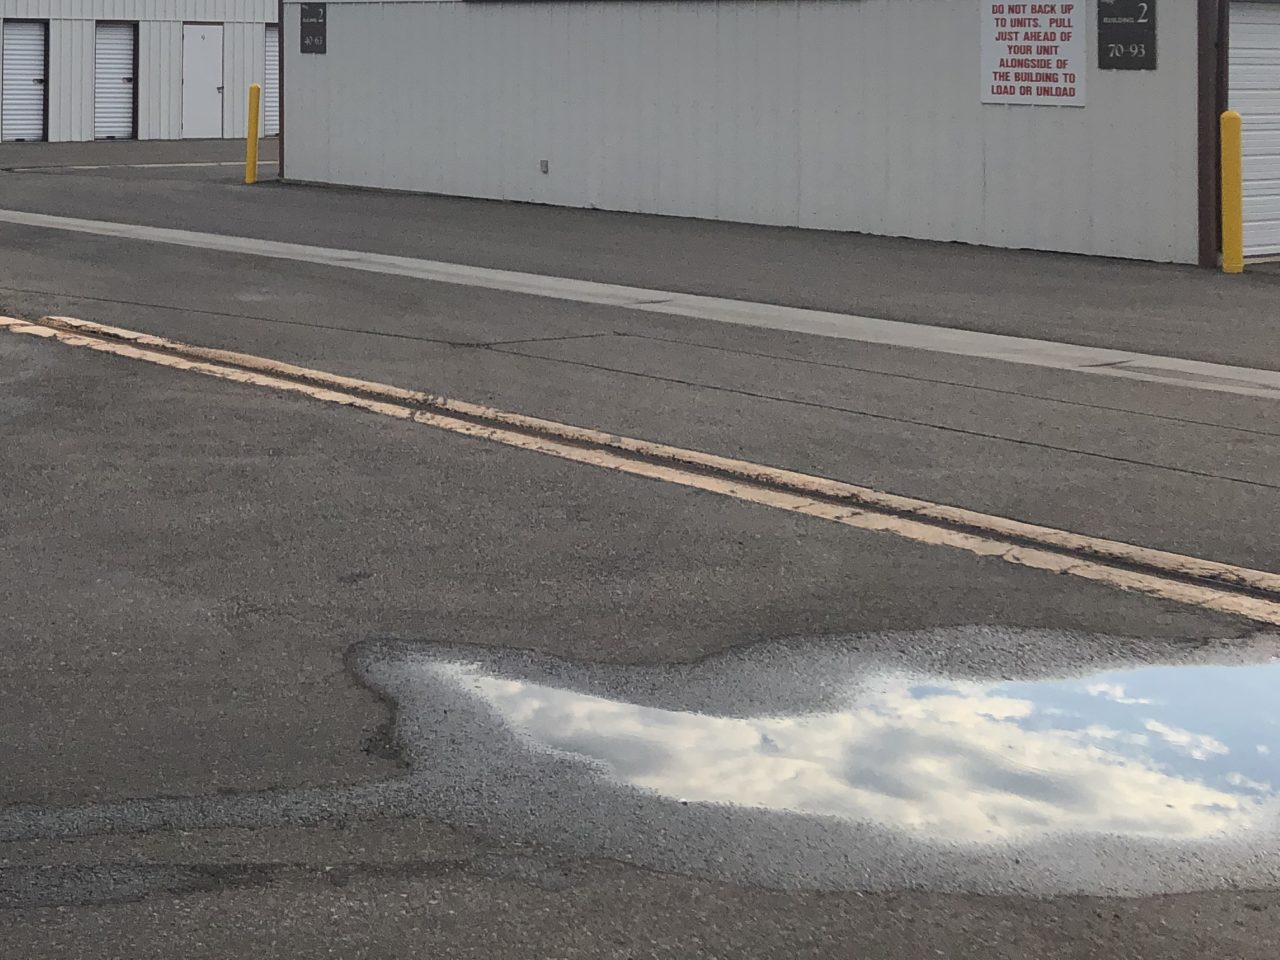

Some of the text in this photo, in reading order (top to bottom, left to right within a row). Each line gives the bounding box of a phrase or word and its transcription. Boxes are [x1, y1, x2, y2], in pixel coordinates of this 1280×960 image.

[991, 4, 1074, 15] DO NOT BACK UP
[1137, 2, 1149, 23] 2
[994, 17, 1074, 28] TO UNITS. PULL
[995, 31, 1073, 42] JUST AHEAD OF
[1007, 44, 1059, 55] YOUR UNIT
[999, 58, 1069, 69] ALONGSIDE OF
[992, 71, 1076, 83] THE BUILDING TO
[991, 85, 1076, 97] LOAD OR UNLOAD
